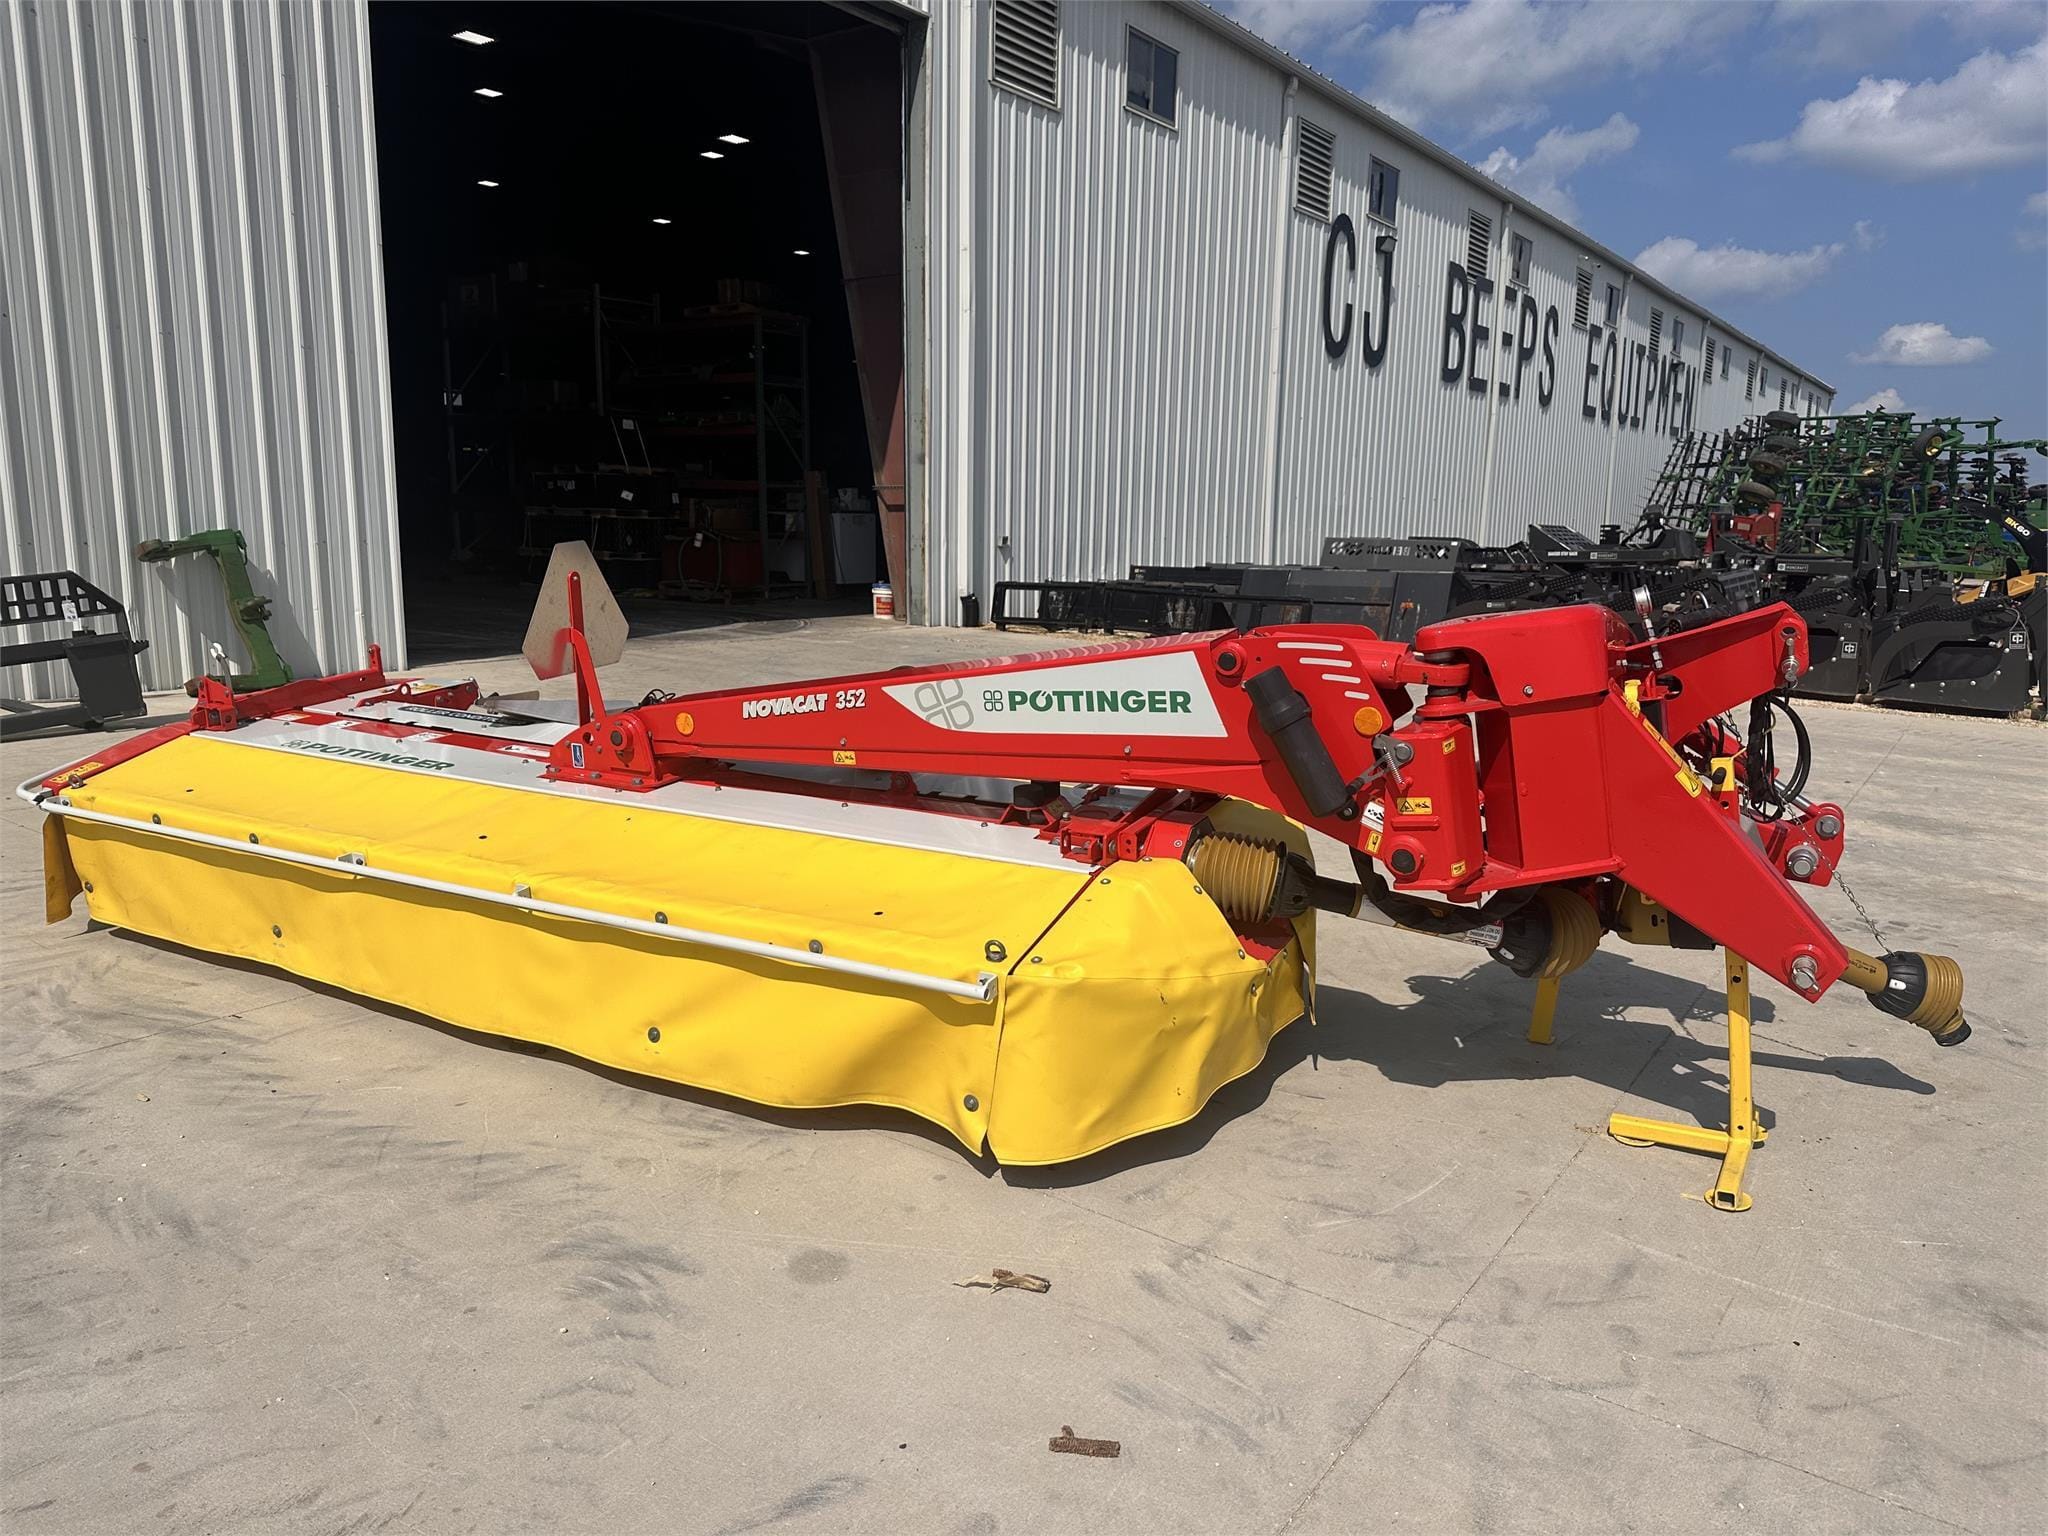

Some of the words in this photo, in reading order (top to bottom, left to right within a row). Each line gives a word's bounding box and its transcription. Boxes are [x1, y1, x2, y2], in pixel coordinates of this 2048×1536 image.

[1323, 213, 1393, 368] CJ
[1441, 260, 1559, 408] BEEPS
[742, 693, 829, 719] NOVACAT
[835, 688, 866, 710] 352
[1007, 690, 1193, 713] PÖTTINGER
